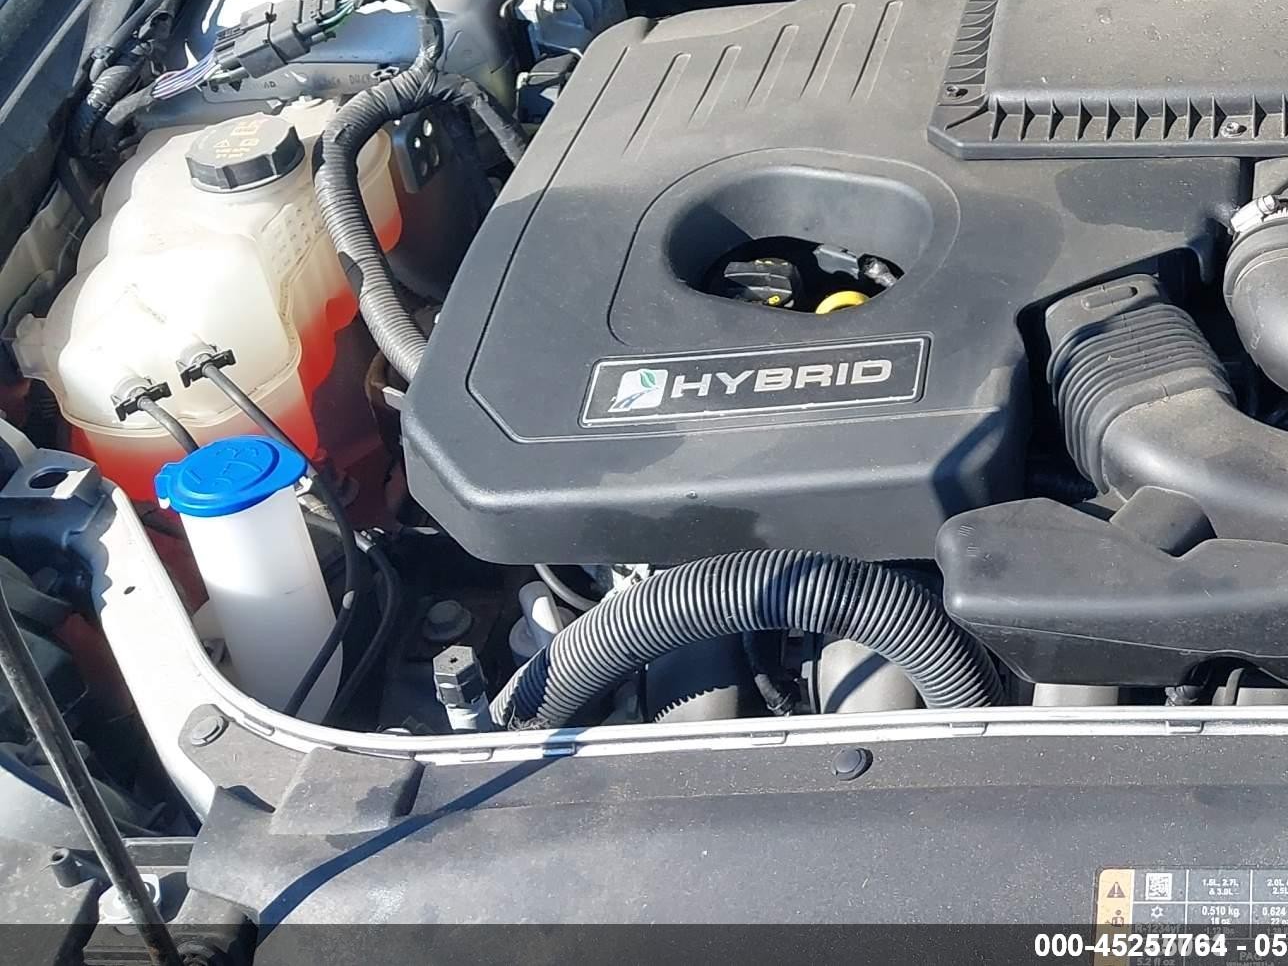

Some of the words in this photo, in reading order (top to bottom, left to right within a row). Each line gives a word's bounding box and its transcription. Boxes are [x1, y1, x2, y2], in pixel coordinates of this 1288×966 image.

[670, 359, 893, 398] HYBRID
[1201, 905, 1226, 916] 0.510
[1228, 905, 1240, 918] kg
[1262, 905, 1286, 916] 0.624
